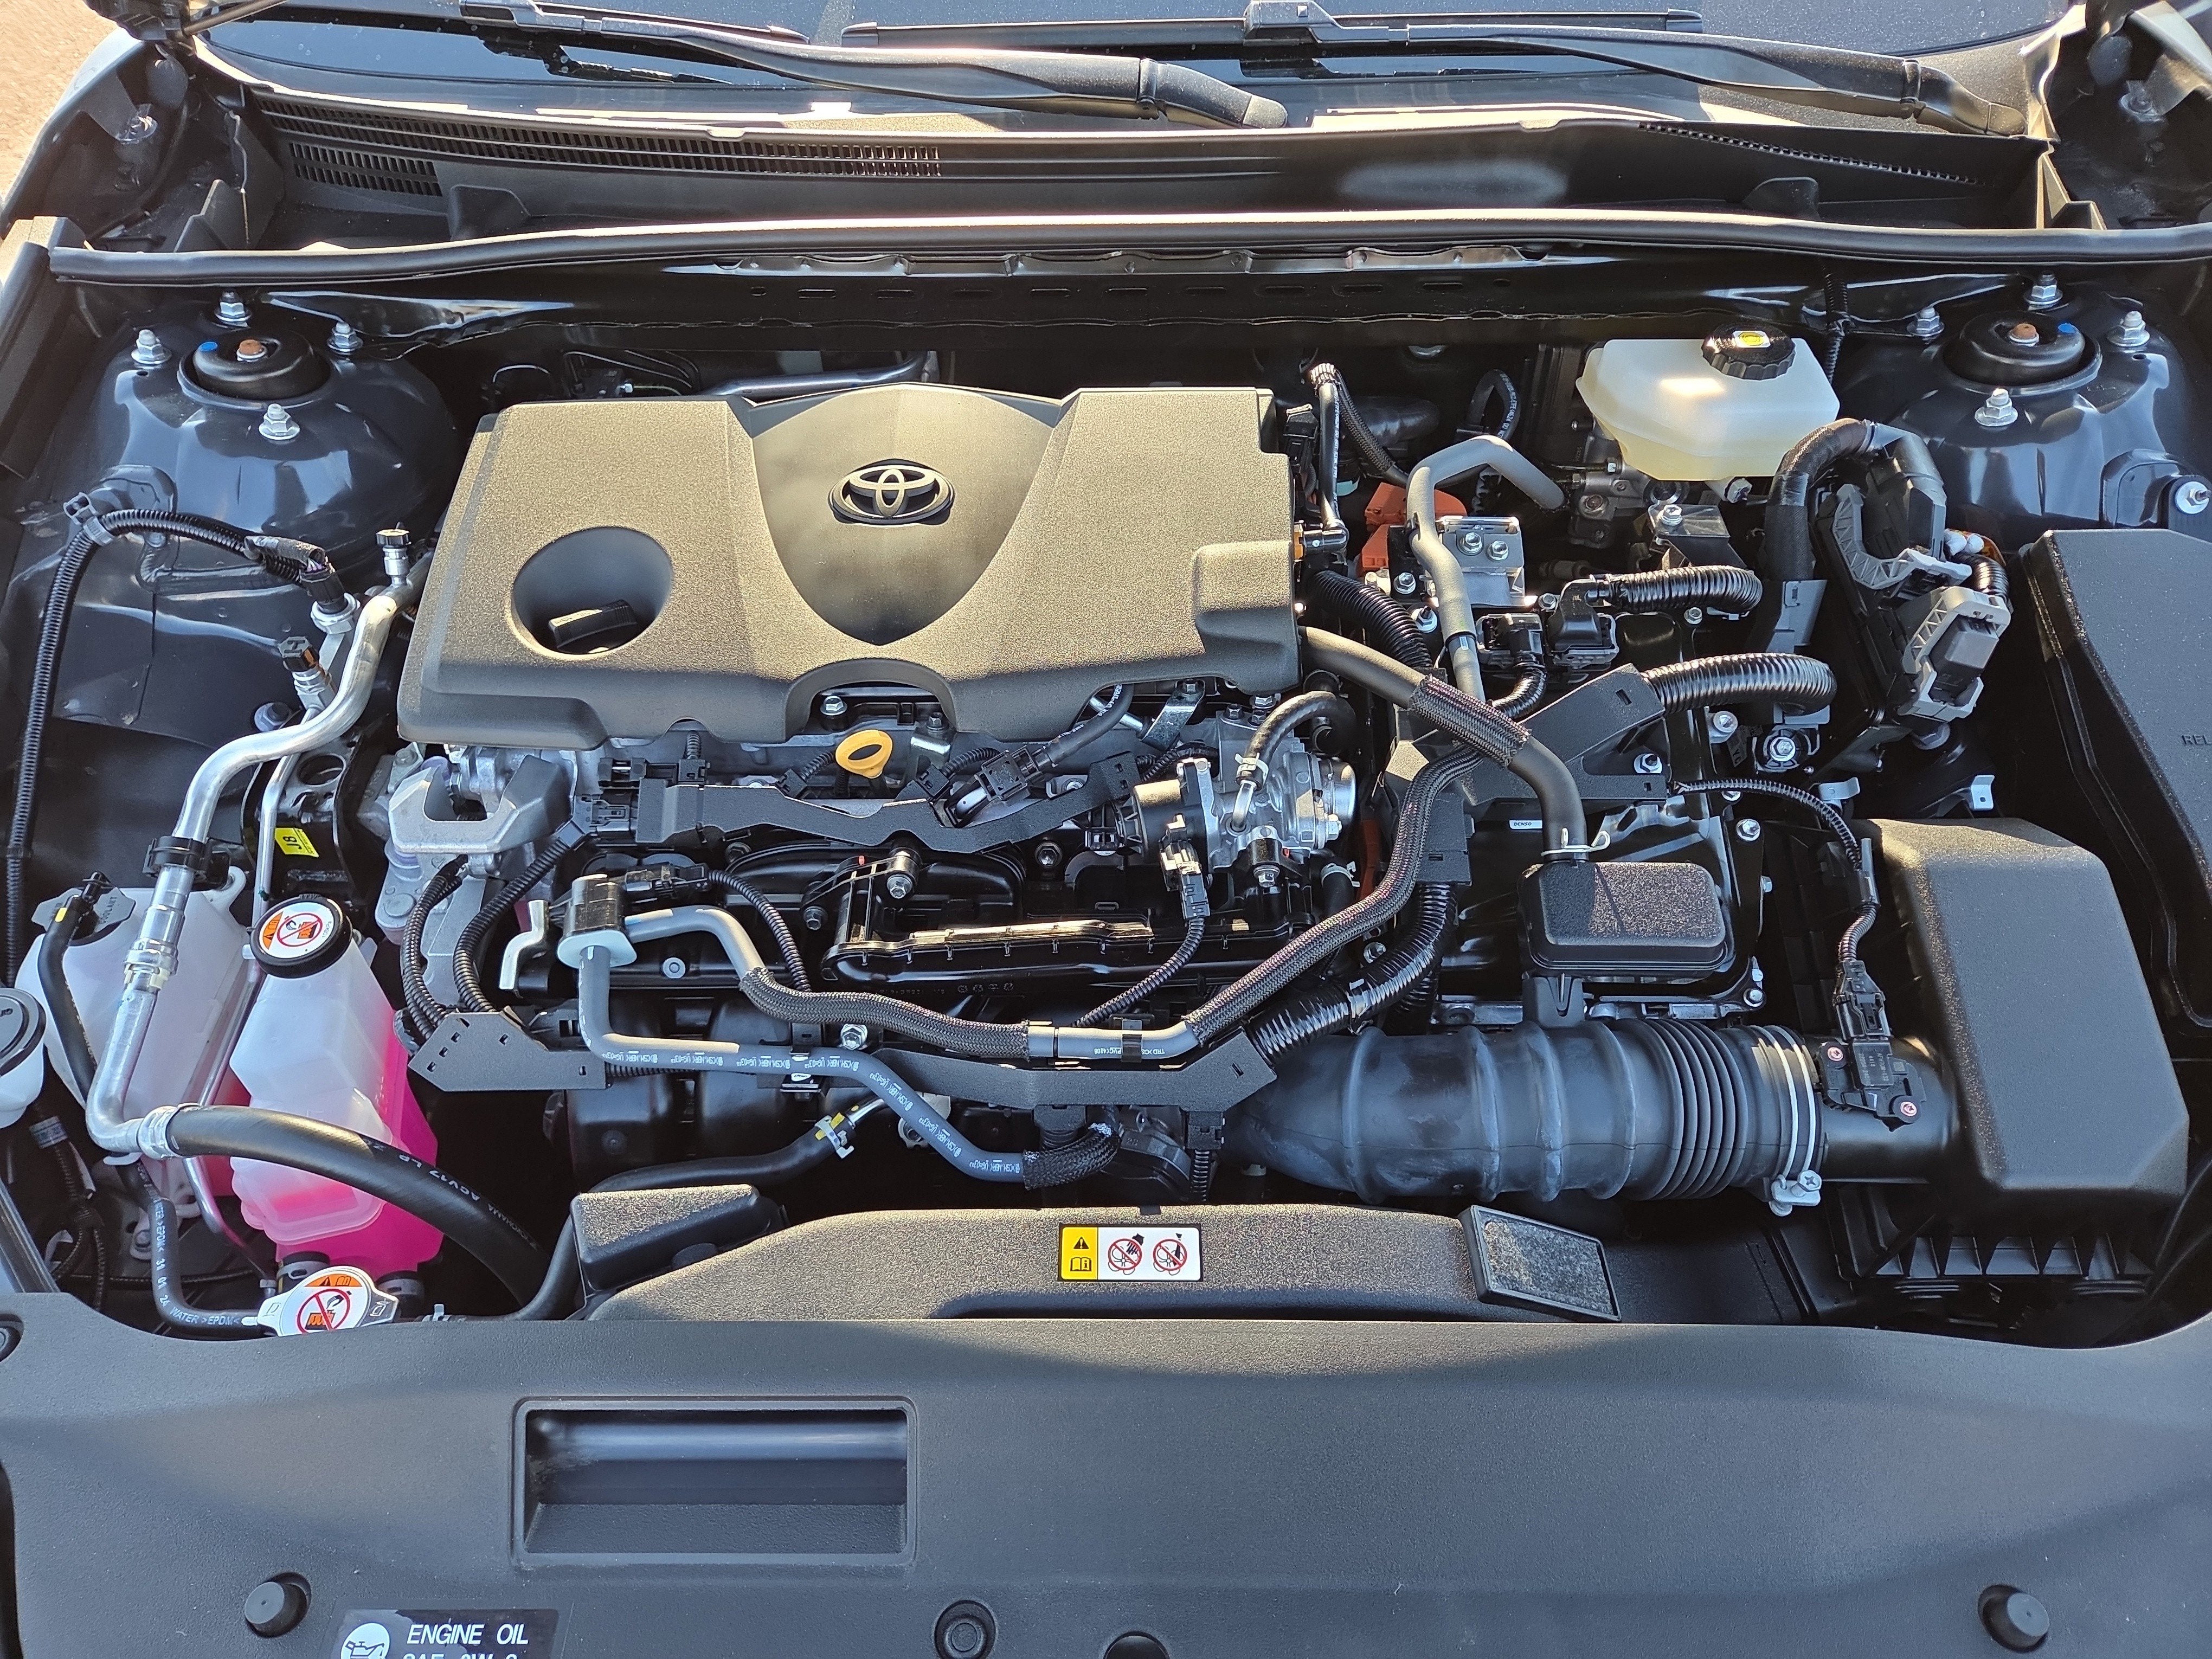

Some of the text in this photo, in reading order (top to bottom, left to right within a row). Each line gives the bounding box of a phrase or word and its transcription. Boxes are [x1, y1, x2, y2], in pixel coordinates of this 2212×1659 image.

[284, 640, 305, 654] H
[156, 1258, 165, 1270] 31
[158, 1276, 167, 1289] 01
[159, 1295, 170, 1308] 24
[169, 1307, 200, 1324] WATER
[407, 1623, 529, 1644] ENGINE OIL
